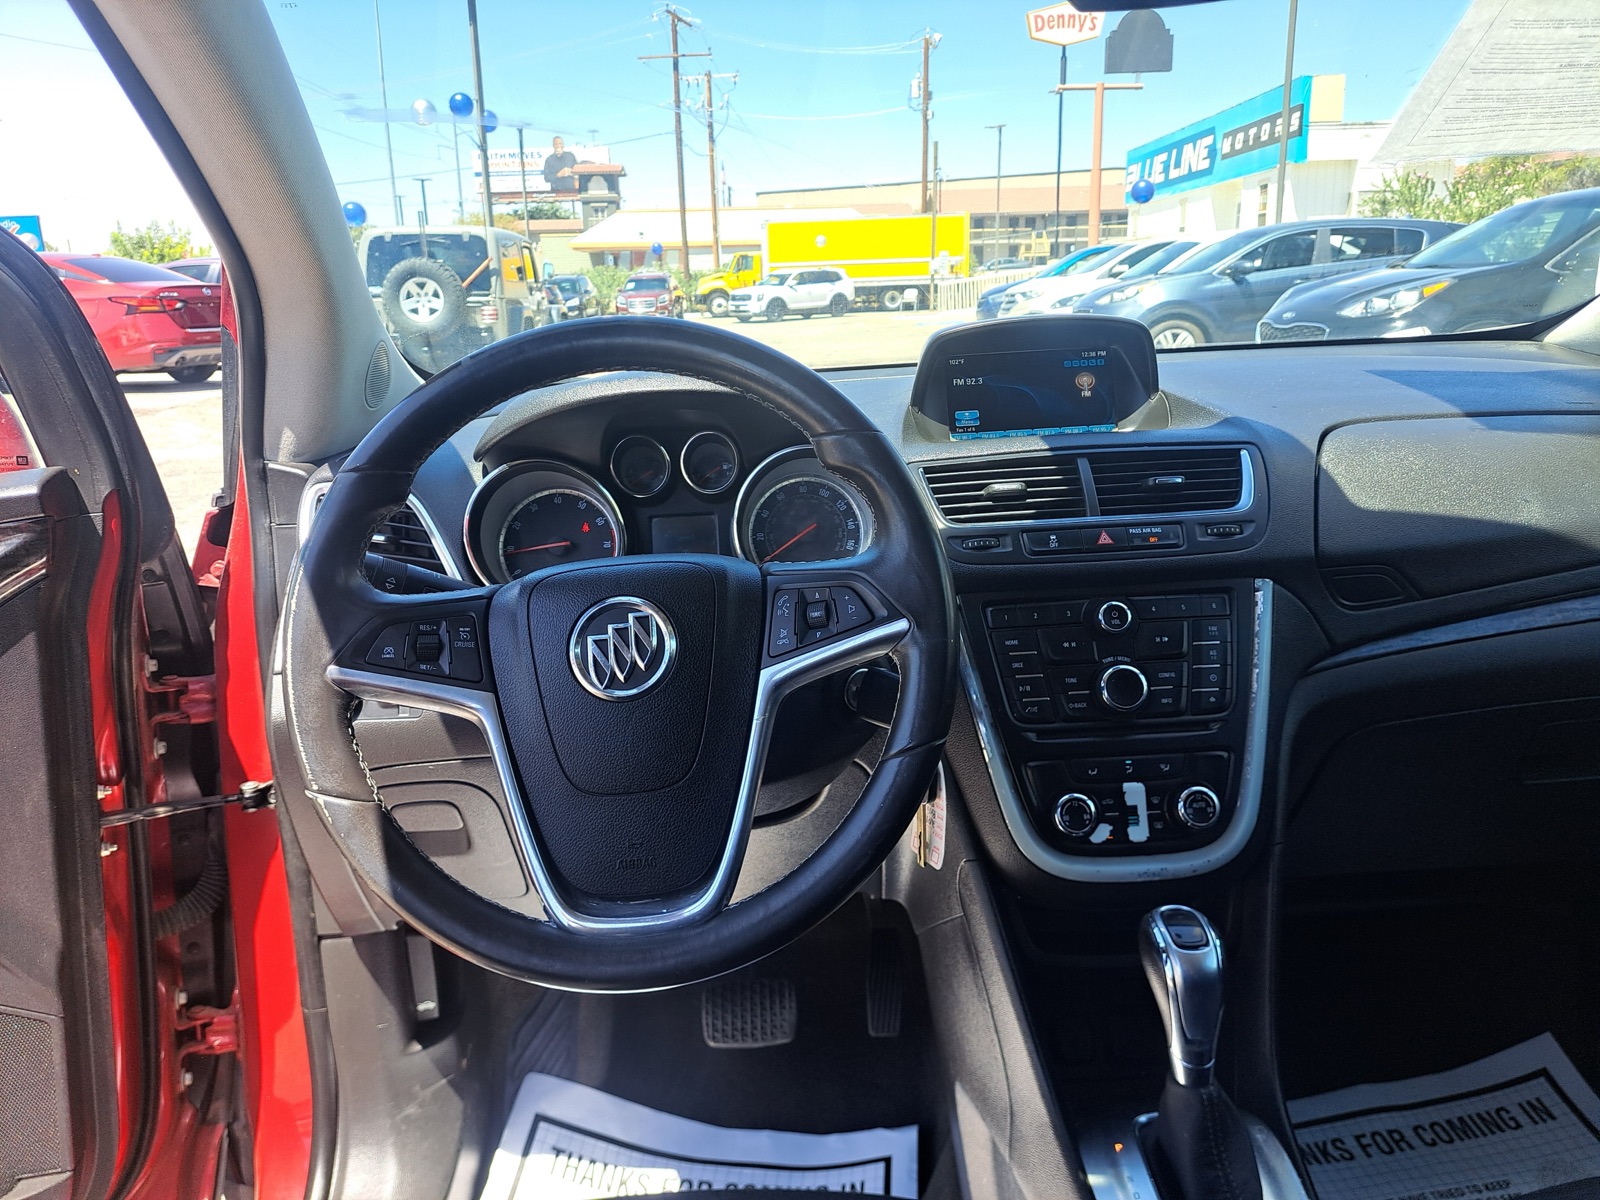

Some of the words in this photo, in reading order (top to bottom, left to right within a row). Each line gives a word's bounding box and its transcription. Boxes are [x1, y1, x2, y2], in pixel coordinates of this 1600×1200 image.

[1033, 12, 1098, 33] Denny's
[1168, 133, 1215, 180] LINE
[953, 378, 965, 386] FM
[966, 377, 983, 385] 92.3
[818, 488, 830, 498] 100
[553, 496, 563, 504] 40
[835, 499, 847, 511] 120
[528, 504, 539, 513] 30
[577, 501, 587, 510] 50
[760, 509, 770, 518] 40
[513, 521, 522, 531] 20
[846, 518, 855, 530] 140
[756, 532, 765, 541] 20
[846, 539, 854, 551] 160
[1354, 1128, 1414, 1158] FOR
[1413, 1106, 1523, 1149] COMING
[1518, 1096, 1557, 1126] IN
[1114, 1143, 1123, 1152] P
